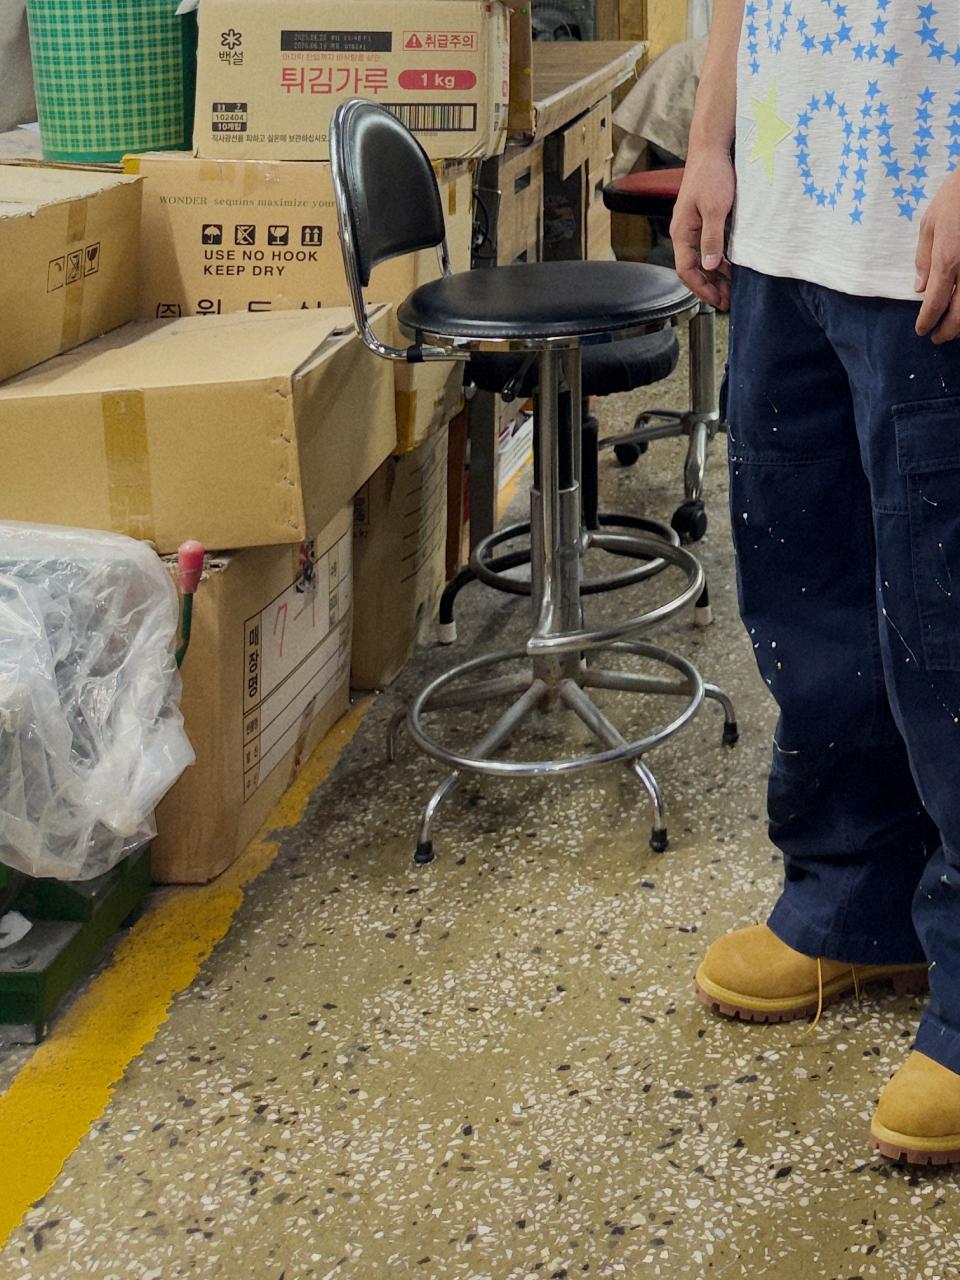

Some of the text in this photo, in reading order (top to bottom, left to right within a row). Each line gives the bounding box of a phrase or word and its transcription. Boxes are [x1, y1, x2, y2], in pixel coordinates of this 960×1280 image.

[425, 33, 475, 49] 취급주의
[217, 50, 244, 66] 백설
[280, 68, 389, 95] 튀김가루
[434, 72, 456, 89] kg
[215, 113, 245, 121] 102404
[158, 195, 208, 207] WONDER
[213, 198, 254, 209] sequins
[257, 197, 310, 208] maximize
[204, 249, 318, 262] USE NO HOOK
[203, 264, 286, 277] KEEP DRY
